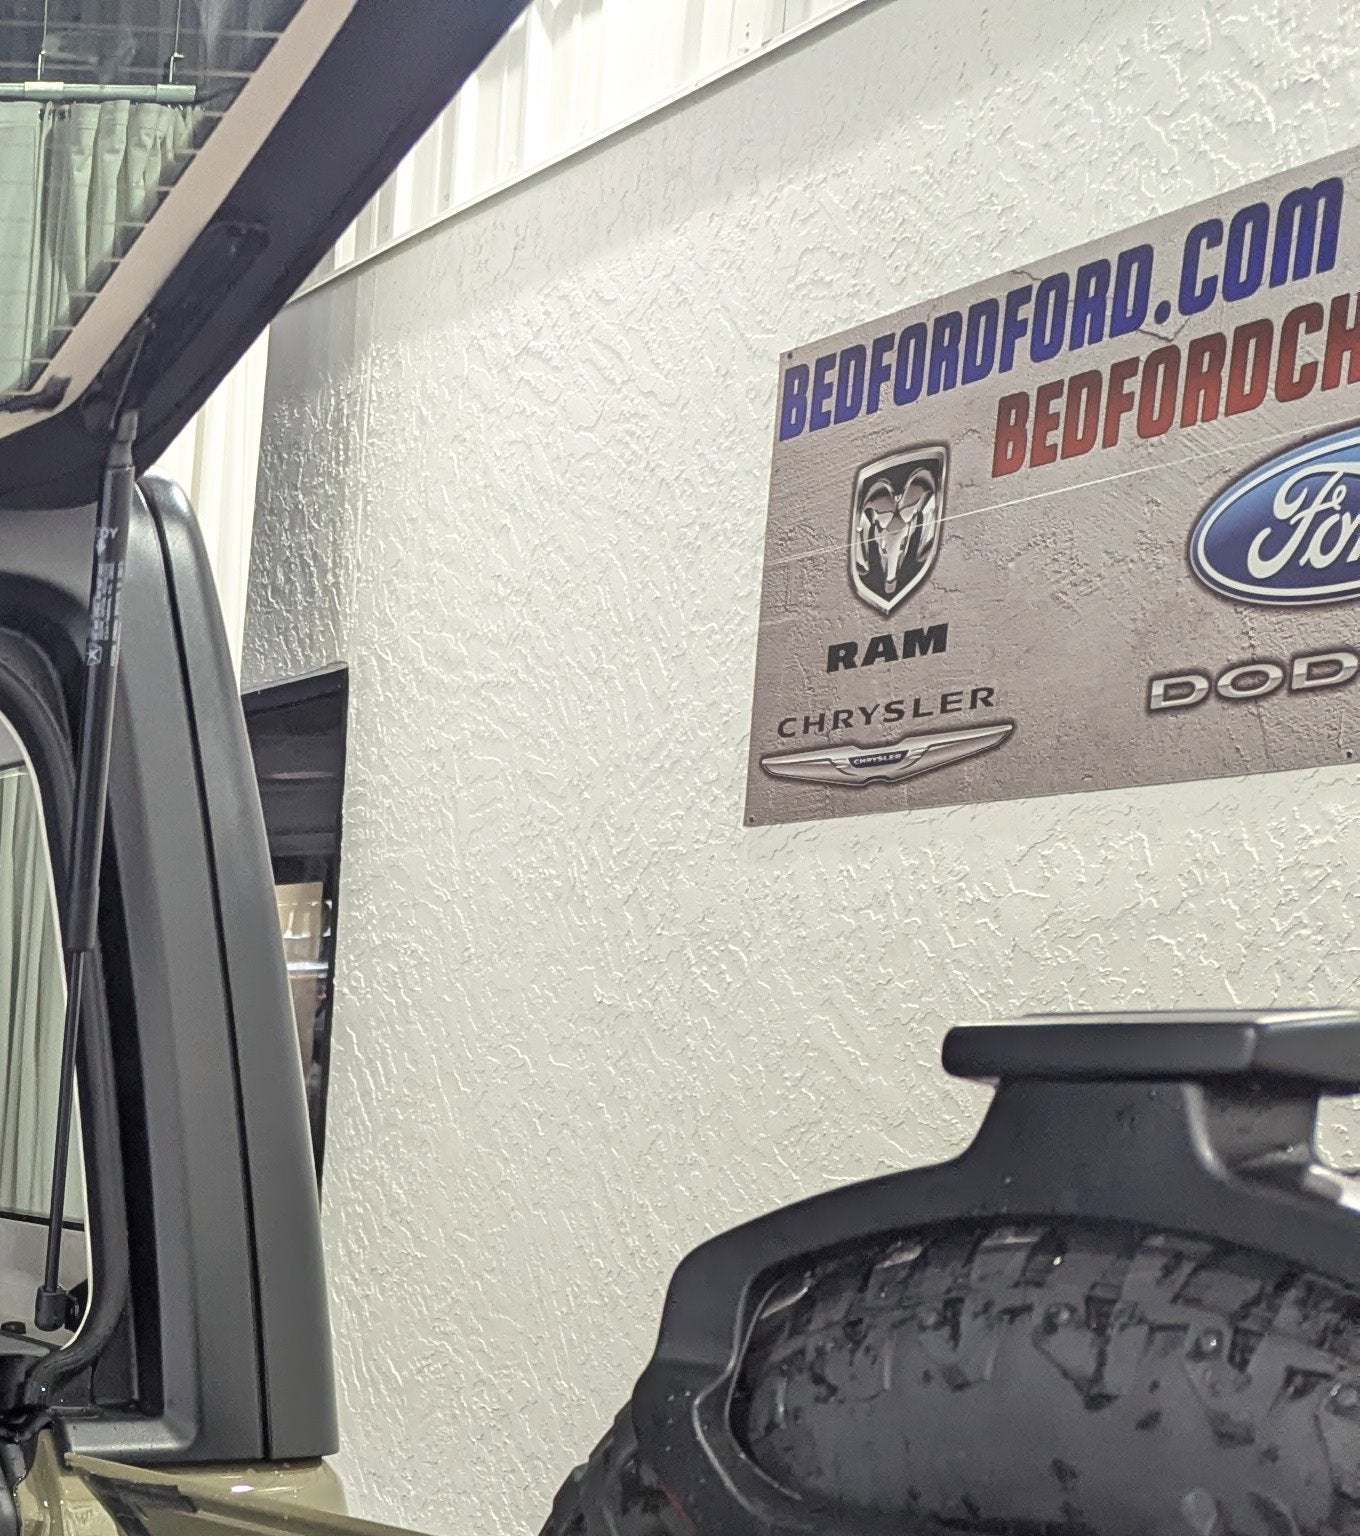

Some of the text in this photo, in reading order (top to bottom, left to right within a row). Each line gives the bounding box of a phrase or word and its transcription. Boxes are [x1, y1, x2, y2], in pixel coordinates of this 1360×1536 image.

[780, 177, 1344, 442] BEDFORDFORD.COM
[826, 623, 949, 673] RAM
[777, 686, 997, 739] CHRYSLER
[853, 753, 903, 765] CHRYSLER
